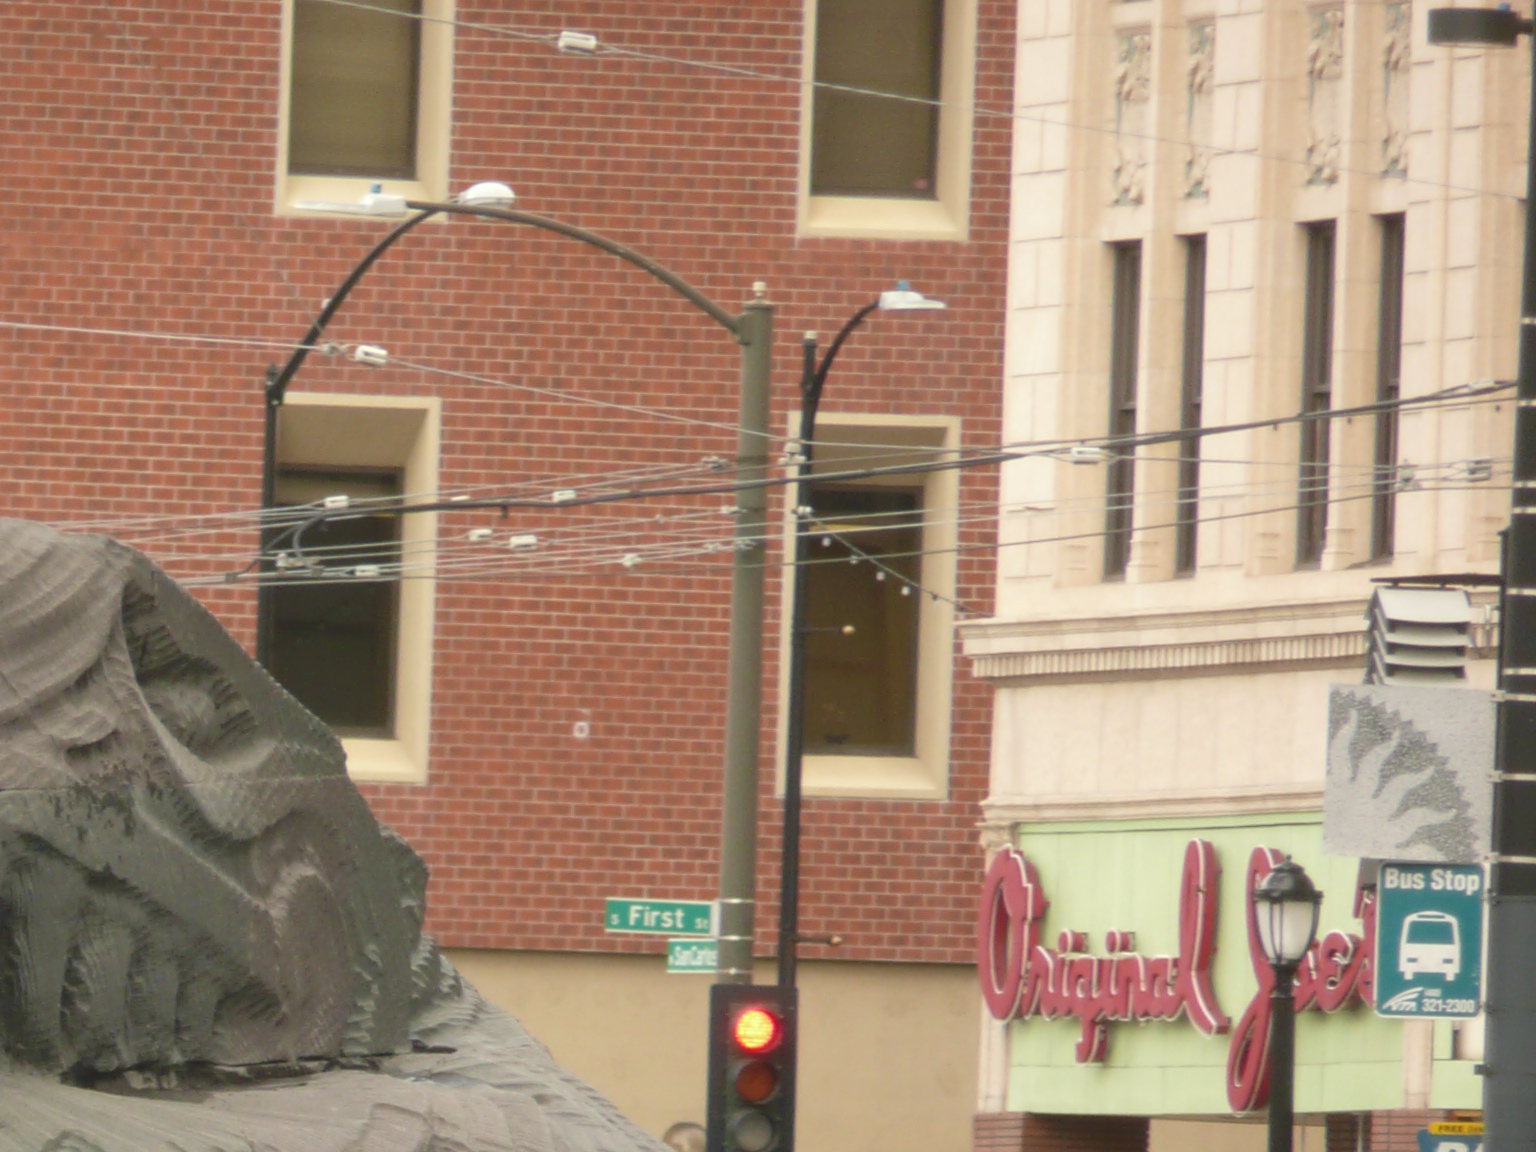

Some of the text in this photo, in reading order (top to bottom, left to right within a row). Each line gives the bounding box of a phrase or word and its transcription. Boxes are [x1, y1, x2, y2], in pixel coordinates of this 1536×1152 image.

[1384, 867, 1481, 896] Bus Stop
[610, 905, 710, 930] S First St
[977, 838, 1231, 1064] Original
[1421, 998, 1475, 1013] 321-2300
